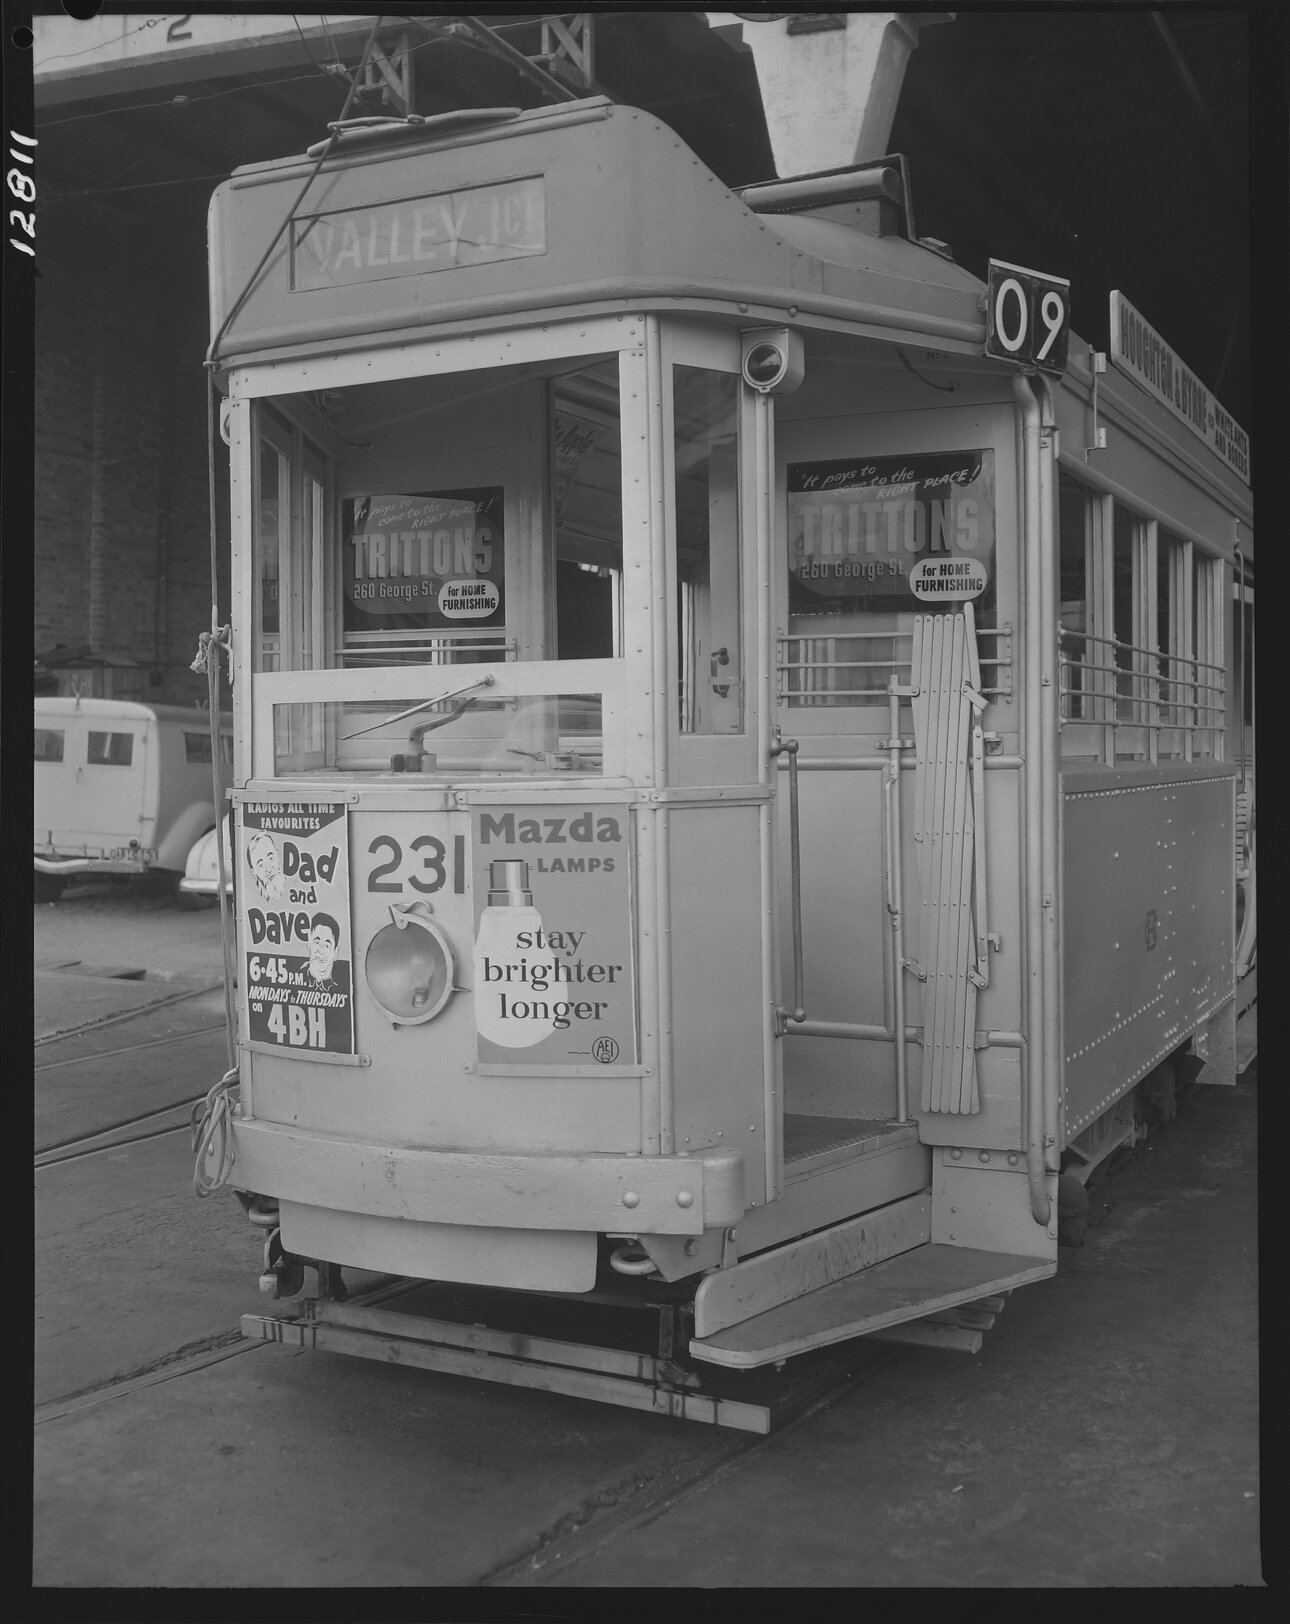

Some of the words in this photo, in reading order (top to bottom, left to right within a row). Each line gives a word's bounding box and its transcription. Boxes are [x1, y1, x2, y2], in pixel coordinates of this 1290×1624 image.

[6, 129, 39, 257] 12811
[310, 201, 469, 271] VALLEY
[1120, 303, 1173, 402] HOUGHTON
[1181, 367, 1207, 435] BYRNE
[1215, 429, 1226, 456] AND
[1234, 426, 1247, 456] ANTS
[820, 470, 857, 489] pays
[861, 465, 876, 476] to
[834, 480, 867, 497] come
[870, 474, 888, 486] to
[891, 467, 915, 482] the
[876, 481, 918, 500] RIGHT
[368, 503, 397, 520] pays
[399, 498, 412, 508] to
[378, 512, 404, 527] come
[407, 508, 421, 518] to
[424, 500, 441, 513] the
[412, 512, 446, 528] RIGHT
[797, 498, 979, 556] TRITTONS
[352, 527, 493, 579] TRITTONS
[802, 562, 829, 579] 260
[834, 560, 884, 582] George
[888, 559, 908, 576] St.
[922, 564, 937, 577] for
[939, 563, 971, 576] HOME
[353, 582, 375, 601] 260
[379, 582, 418, 602] George
[421, 580, 437, 597] St.
[448, 585, 459, 596] for
[461, 584, 486, 596] HOME
[915, 577, 983, 592] FURNISHING
[442, 597, 496, 610] FURNISHING
[247, 803, 284, 814] RADIOS
[288, 803, 304, 814] ALL
[307, 803, 335, 814] TIME
[260, 817, 321, 830] FAVOURITES
[480, 811, 622, 845] Mazda
[283, 841, 339, 884] Dad
[367, 834, 465, 894] 231
[537, 856, 616, 874] LAMPS
[290, 885, 318, 905] and
[247, 907, 311, 945] Dave
[516, 925, 586, 955] stay
[288, 972, 307, 986] P.M.
[482, 956, 622, 991] brighter
[248, 986, 291, 1003] MONDAYS
[296, 989, 349, 1008] THURSDAYS
[252, 1002, 263, 1012] on
[499, 993, 608, 1029] longer
[268, 1003, 326, 1048] 4BH
[596, 1039, 614, 1057] AEI
